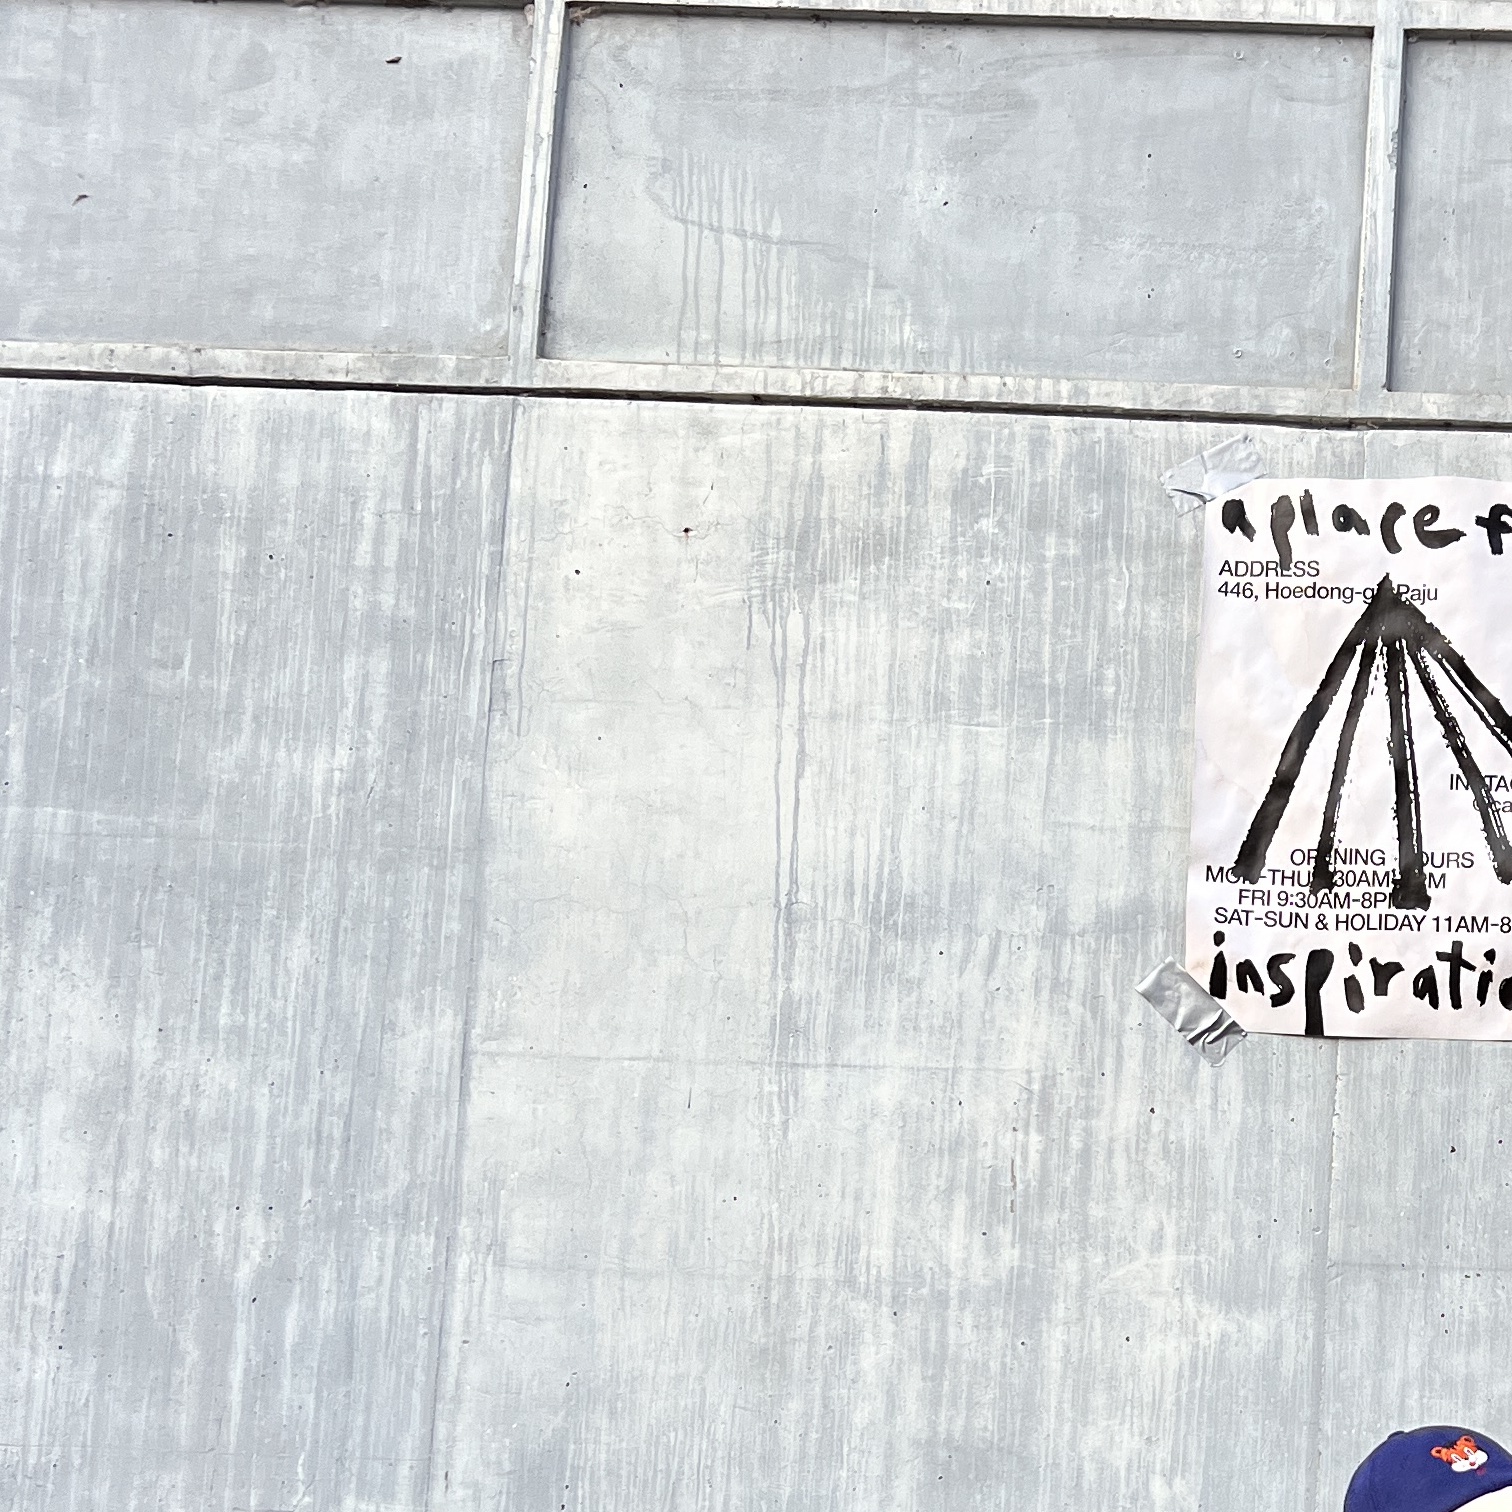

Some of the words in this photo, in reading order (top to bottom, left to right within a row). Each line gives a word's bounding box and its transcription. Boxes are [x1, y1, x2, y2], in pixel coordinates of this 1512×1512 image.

[1221, 499, 1256, 543] a
[1270, 489, 1467, 571] place
[1218, 582, 1258, 602] 446,
[1265, 582, 1388, 606] Hoedong-g
[1397, 584, 1439, 605] Paju
[1290, 848, 1386, 867] OPNING
[1418, 851, 1475, 869] URS
[1205, 865, 1312, 887] MO-THU
[1328, 870, 1446, 888] 30AMM
[1238, 889, 1271, 907] FRI
[1213, 907, 1309, 929] SAT-SUN
[1315, 913, 1329, 931] &
[1335, 913, 1427, 932] HOLIDAY
